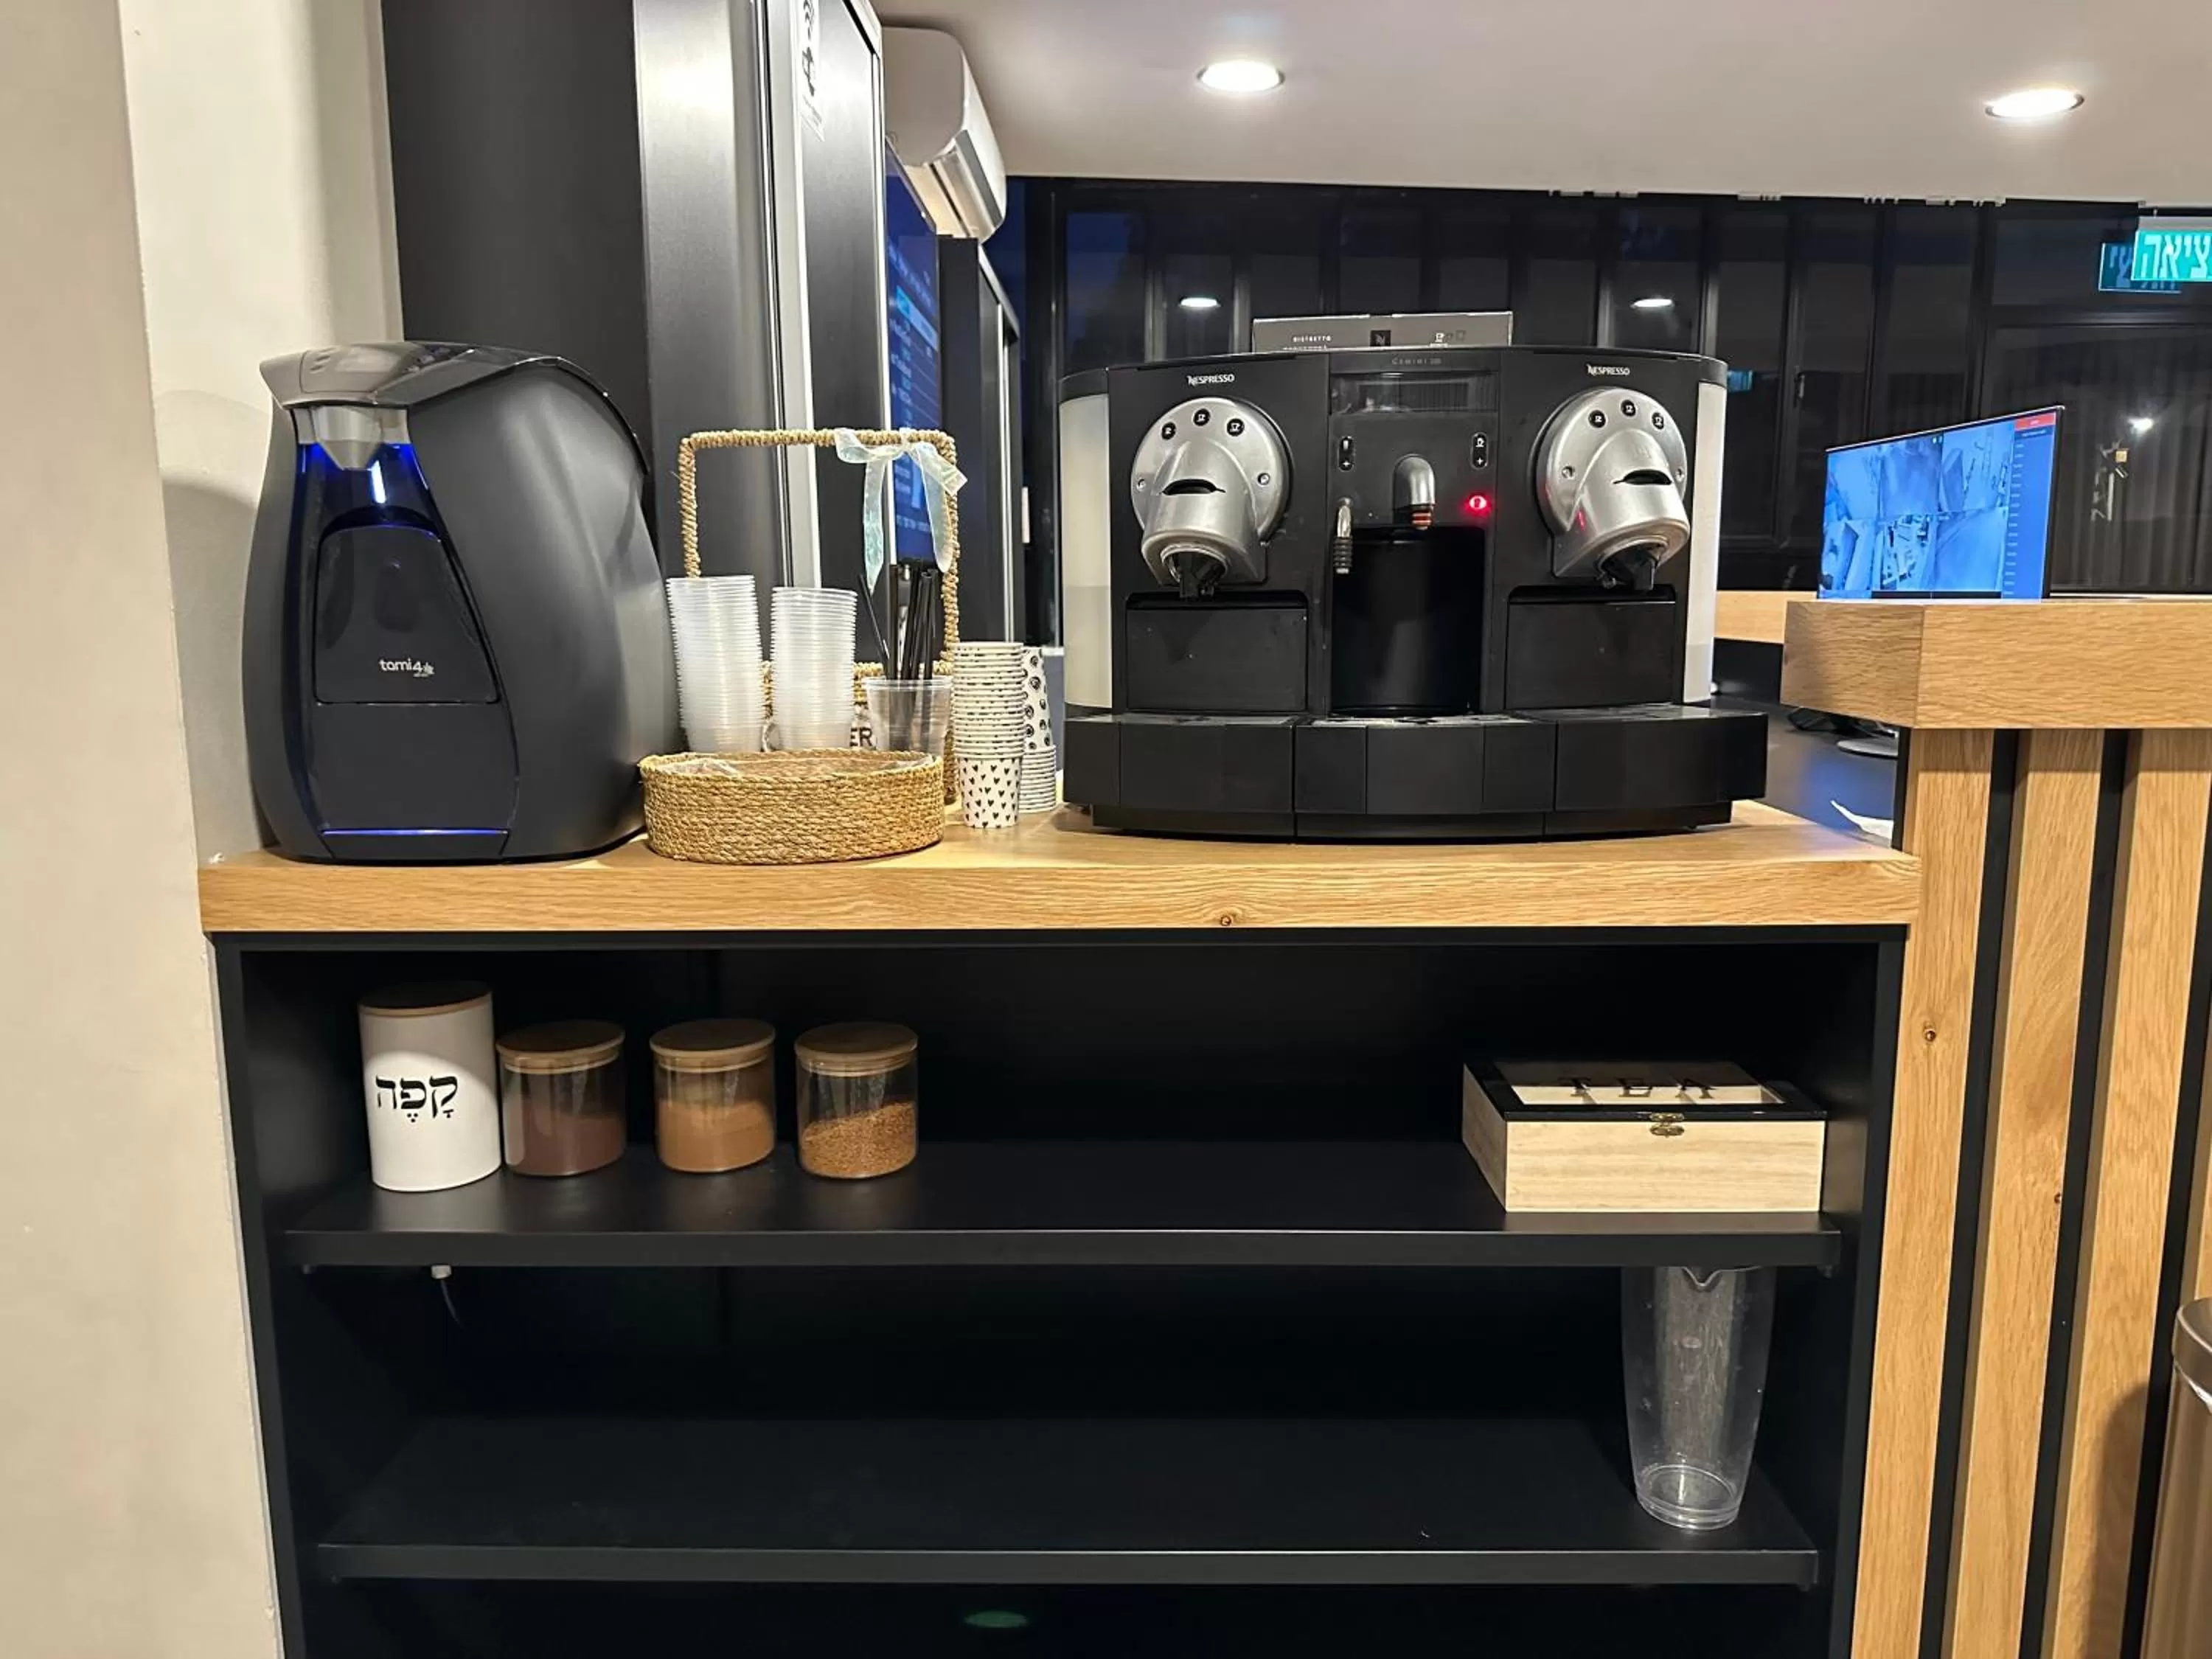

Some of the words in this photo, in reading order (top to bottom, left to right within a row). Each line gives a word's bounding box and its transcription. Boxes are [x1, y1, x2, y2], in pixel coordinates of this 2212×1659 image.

[2140, 234, 2212, 279] ציאה
[1586, 364, 1631, 376] NESPRESSO
[1186, 374, 1235, 386] NESPRESSO
[1557, 1077, 1717, 1099] TEA
